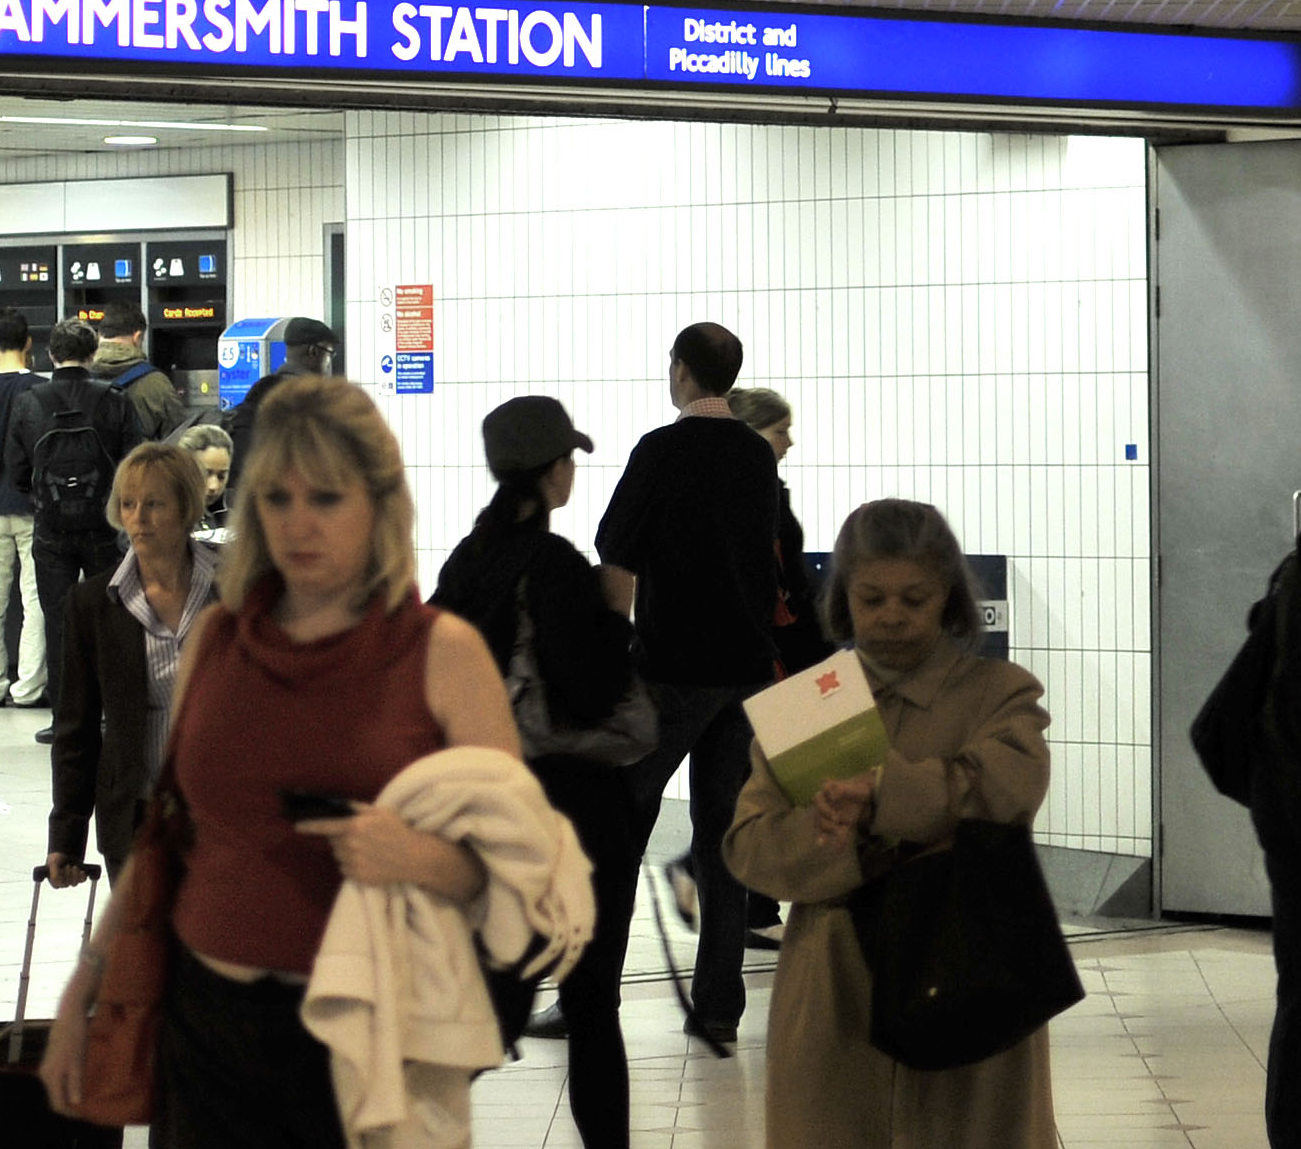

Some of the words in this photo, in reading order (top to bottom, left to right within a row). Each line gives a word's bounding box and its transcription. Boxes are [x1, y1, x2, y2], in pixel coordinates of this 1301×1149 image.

[392, 2, 602, 68] STATION
[683, 17, 757, 47] District
[762, 23, 797, 49] and
[669, 48, 758, 81] Piccadilly
[766, 53, 811, 80] lines
